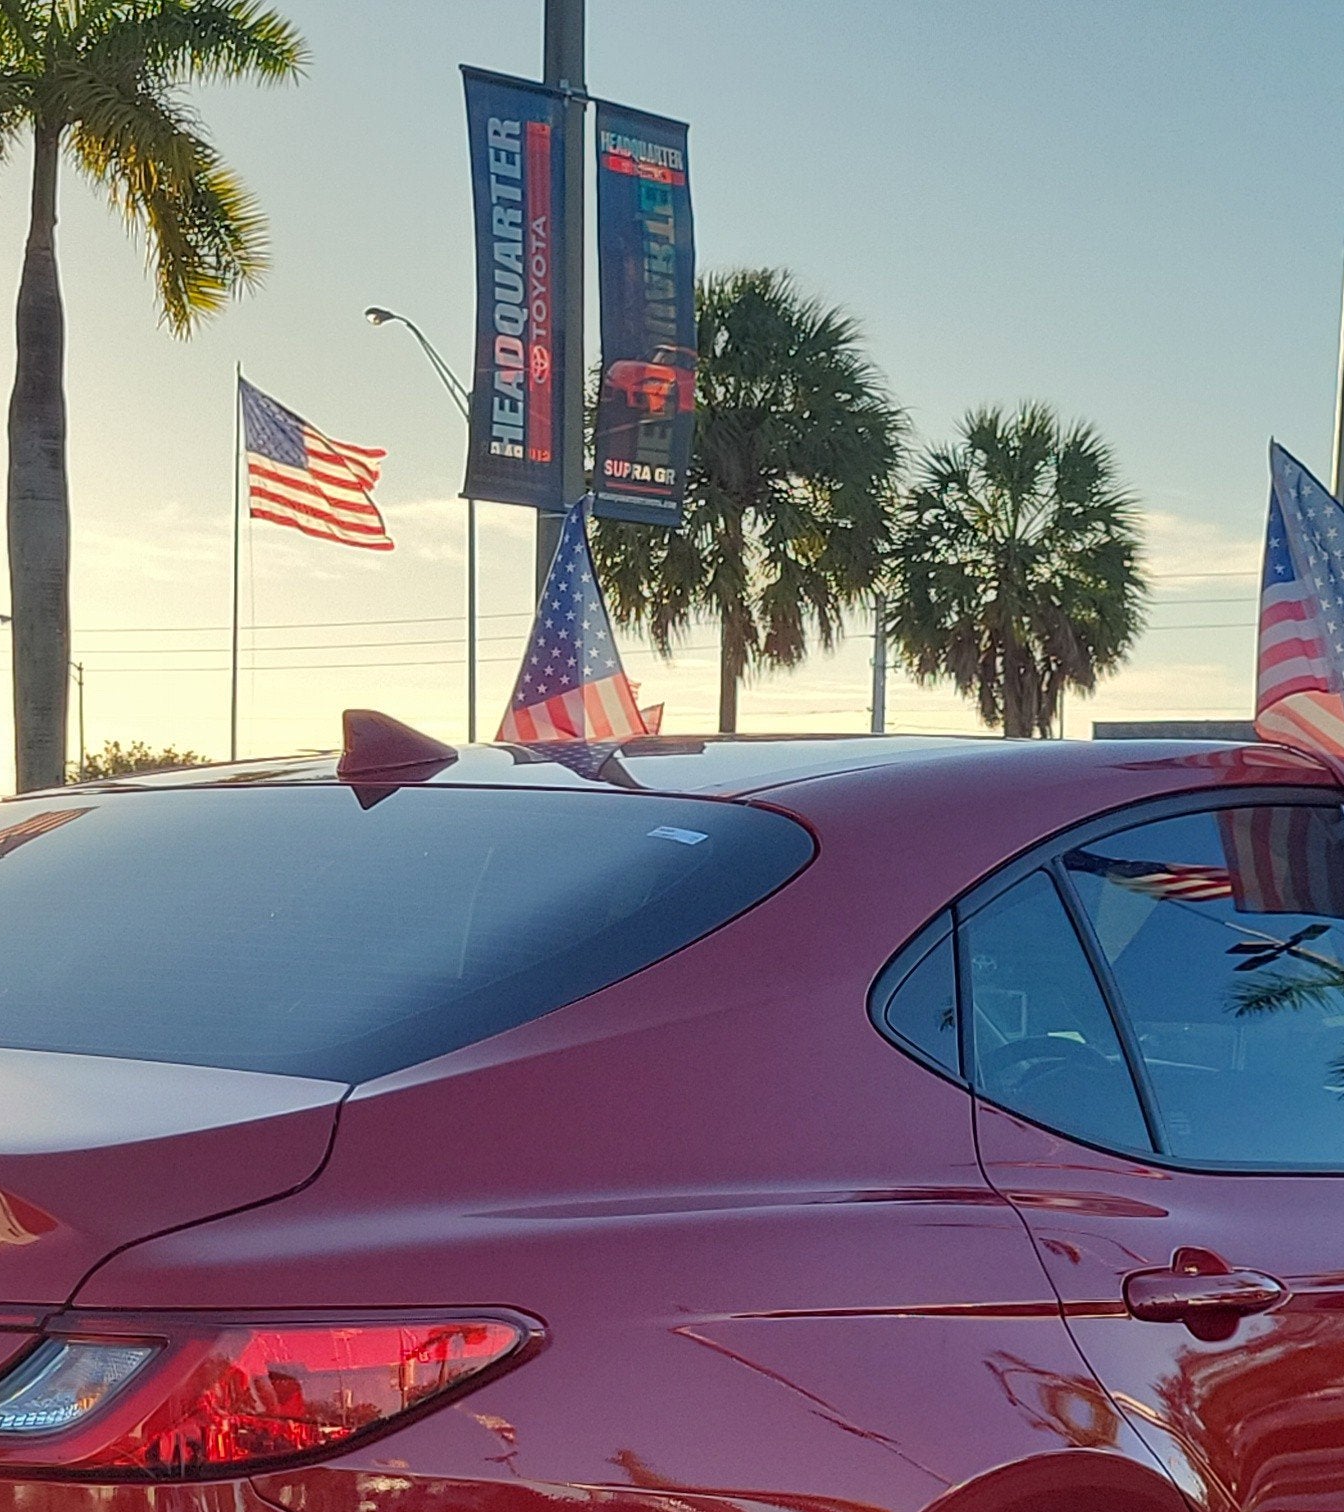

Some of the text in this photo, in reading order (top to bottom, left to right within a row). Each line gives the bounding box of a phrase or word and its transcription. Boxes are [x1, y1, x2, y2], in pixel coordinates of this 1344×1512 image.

[600, 130, 683, 170] HEADQUARTER
[487, 116, 529, 457] HEADQUARTER
[531, 215, 547, 339] TOYOTA
[603, 459, 676, 485] SUPRA GR
